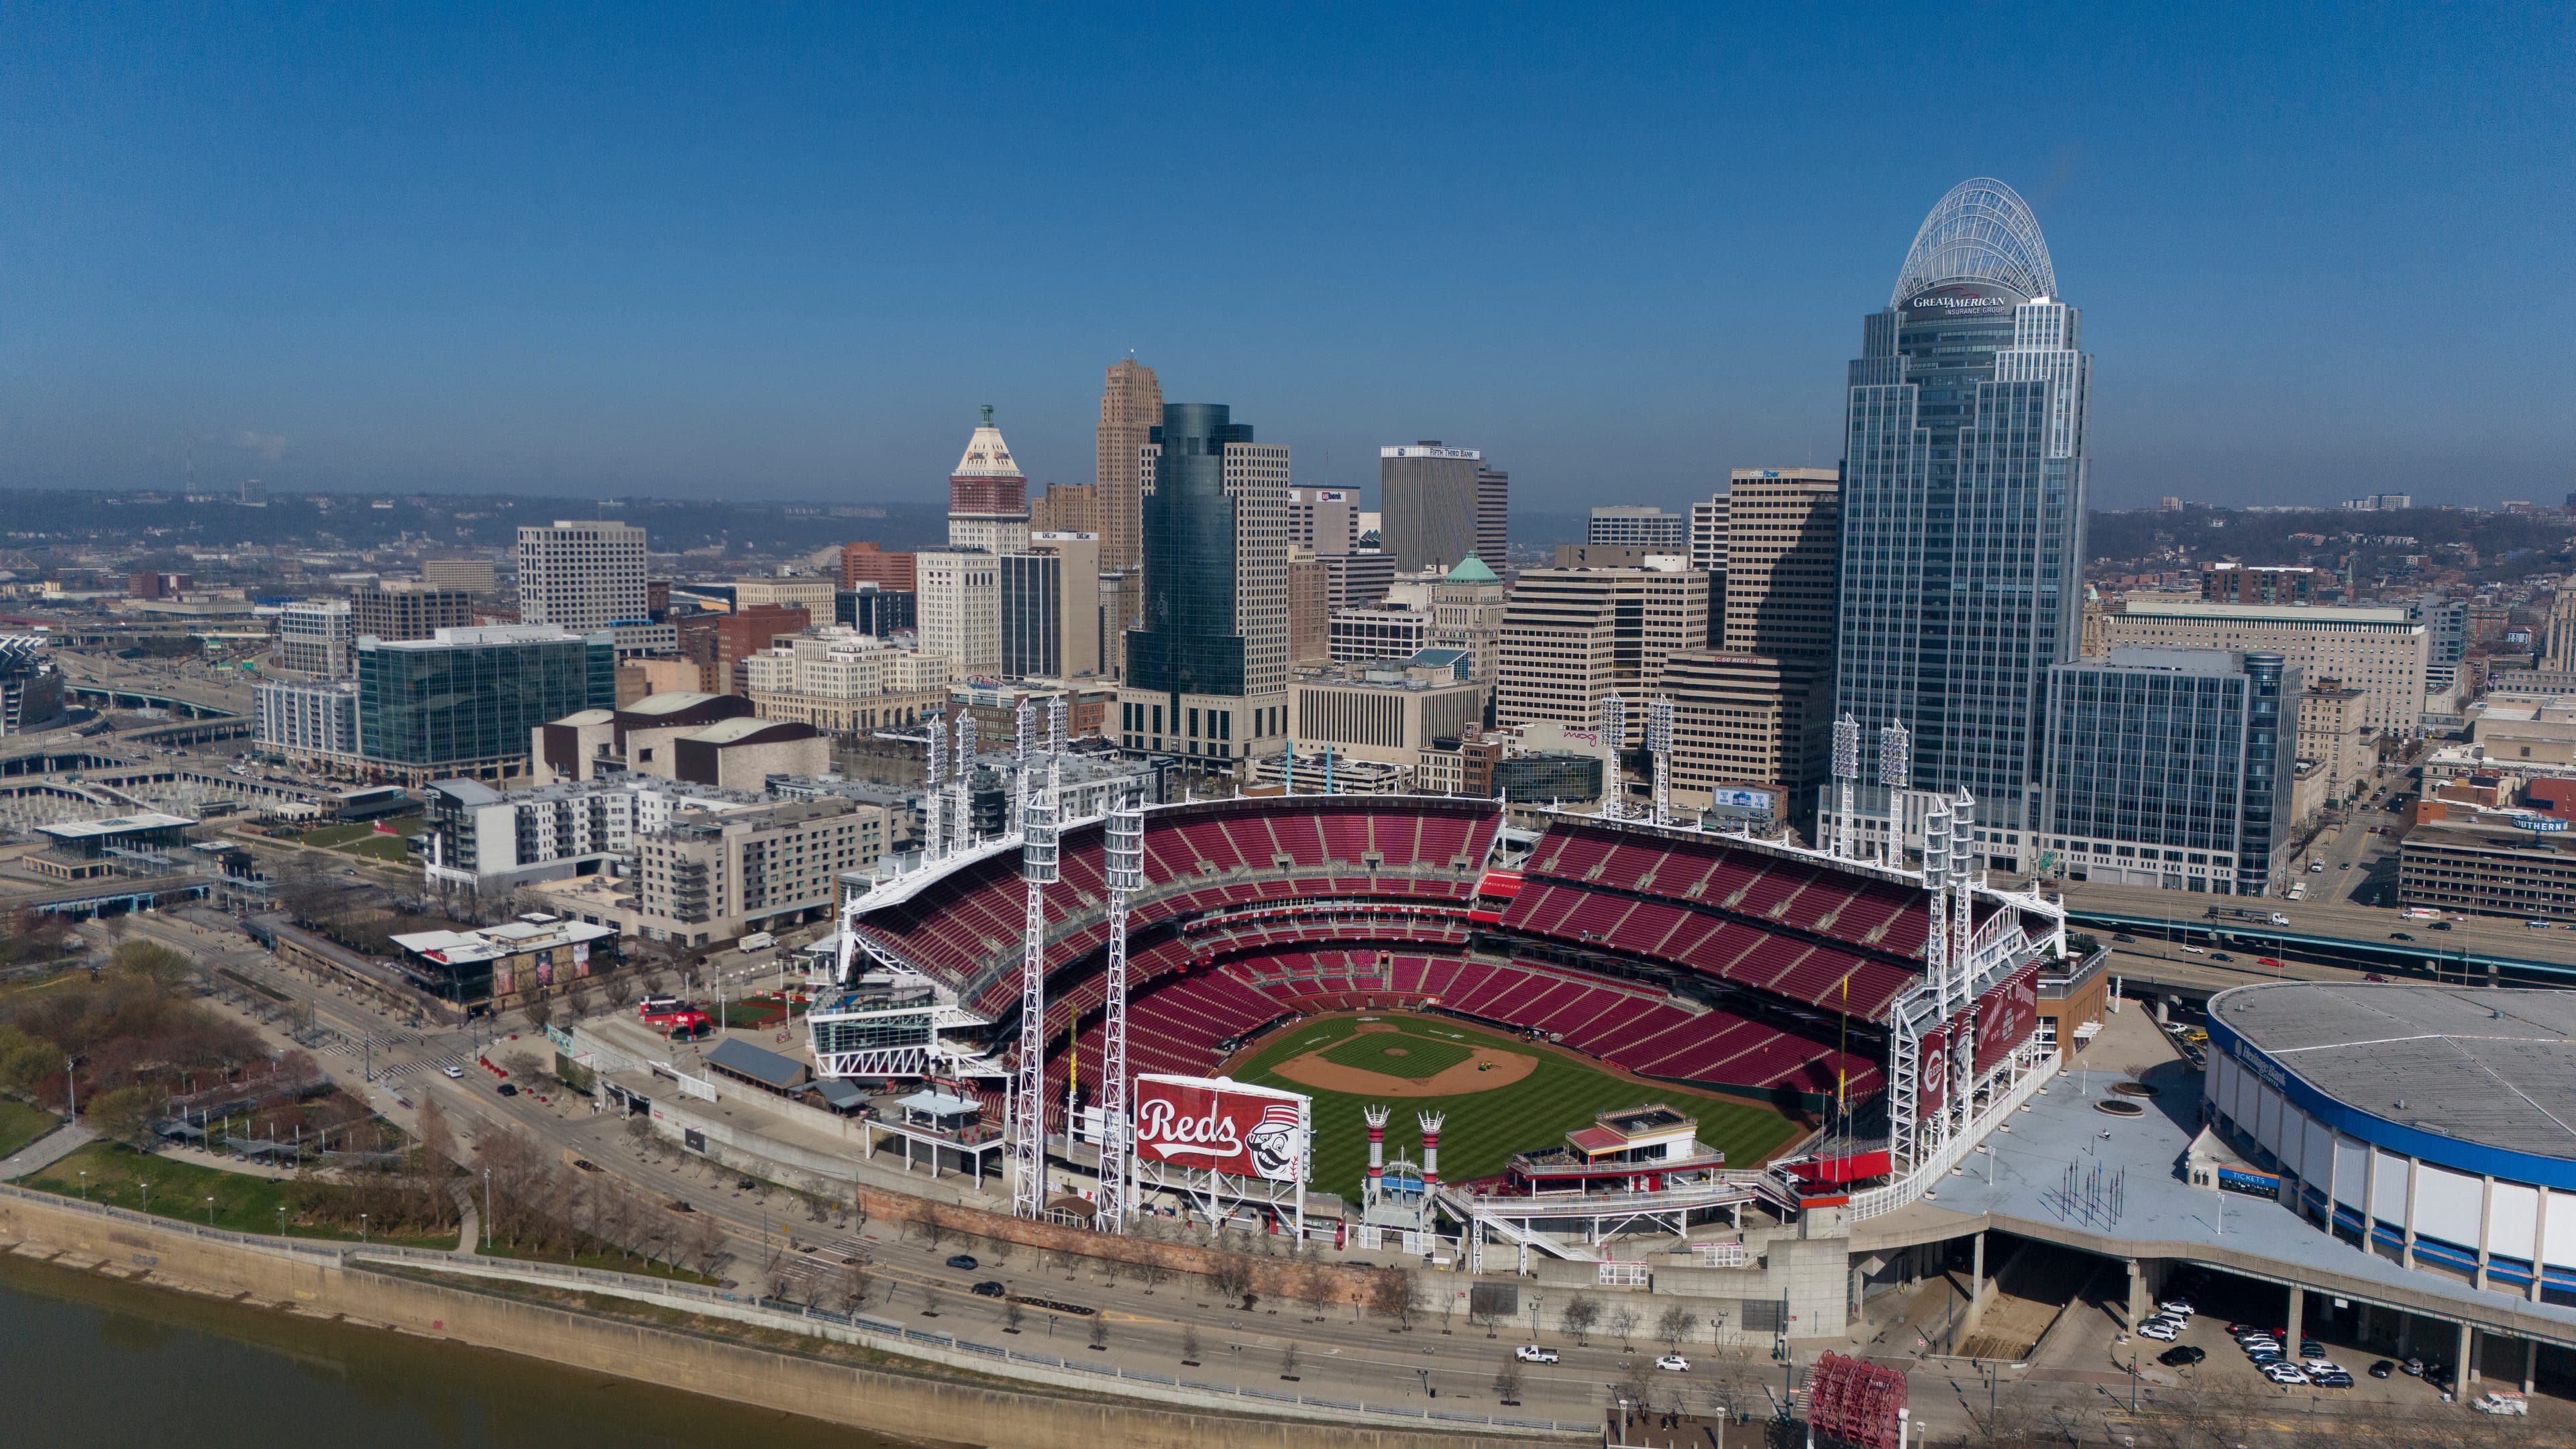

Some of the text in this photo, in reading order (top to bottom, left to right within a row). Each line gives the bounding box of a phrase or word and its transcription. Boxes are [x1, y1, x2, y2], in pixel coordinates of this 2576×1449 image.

[1913, 297, 2006, 309] GREAT AMERICAN
[1945, 308, 1980, 316] INSURANCE
[1430, 448, 1444, 456] FIFTH
[1445, 449, 1459, 457] THIRD
[1563, 731, 1597, 747] moxy
[1979, 993, 2003, 1051] CINCINNATI
[1929, 1061, 1943, 1079] REDS
[2243, 1045, 2286, 1087] Heritage Bank
[1138, 1099, 1243, 1159] Reds
[2232, 1171, 2265, 1184] TICKETS
